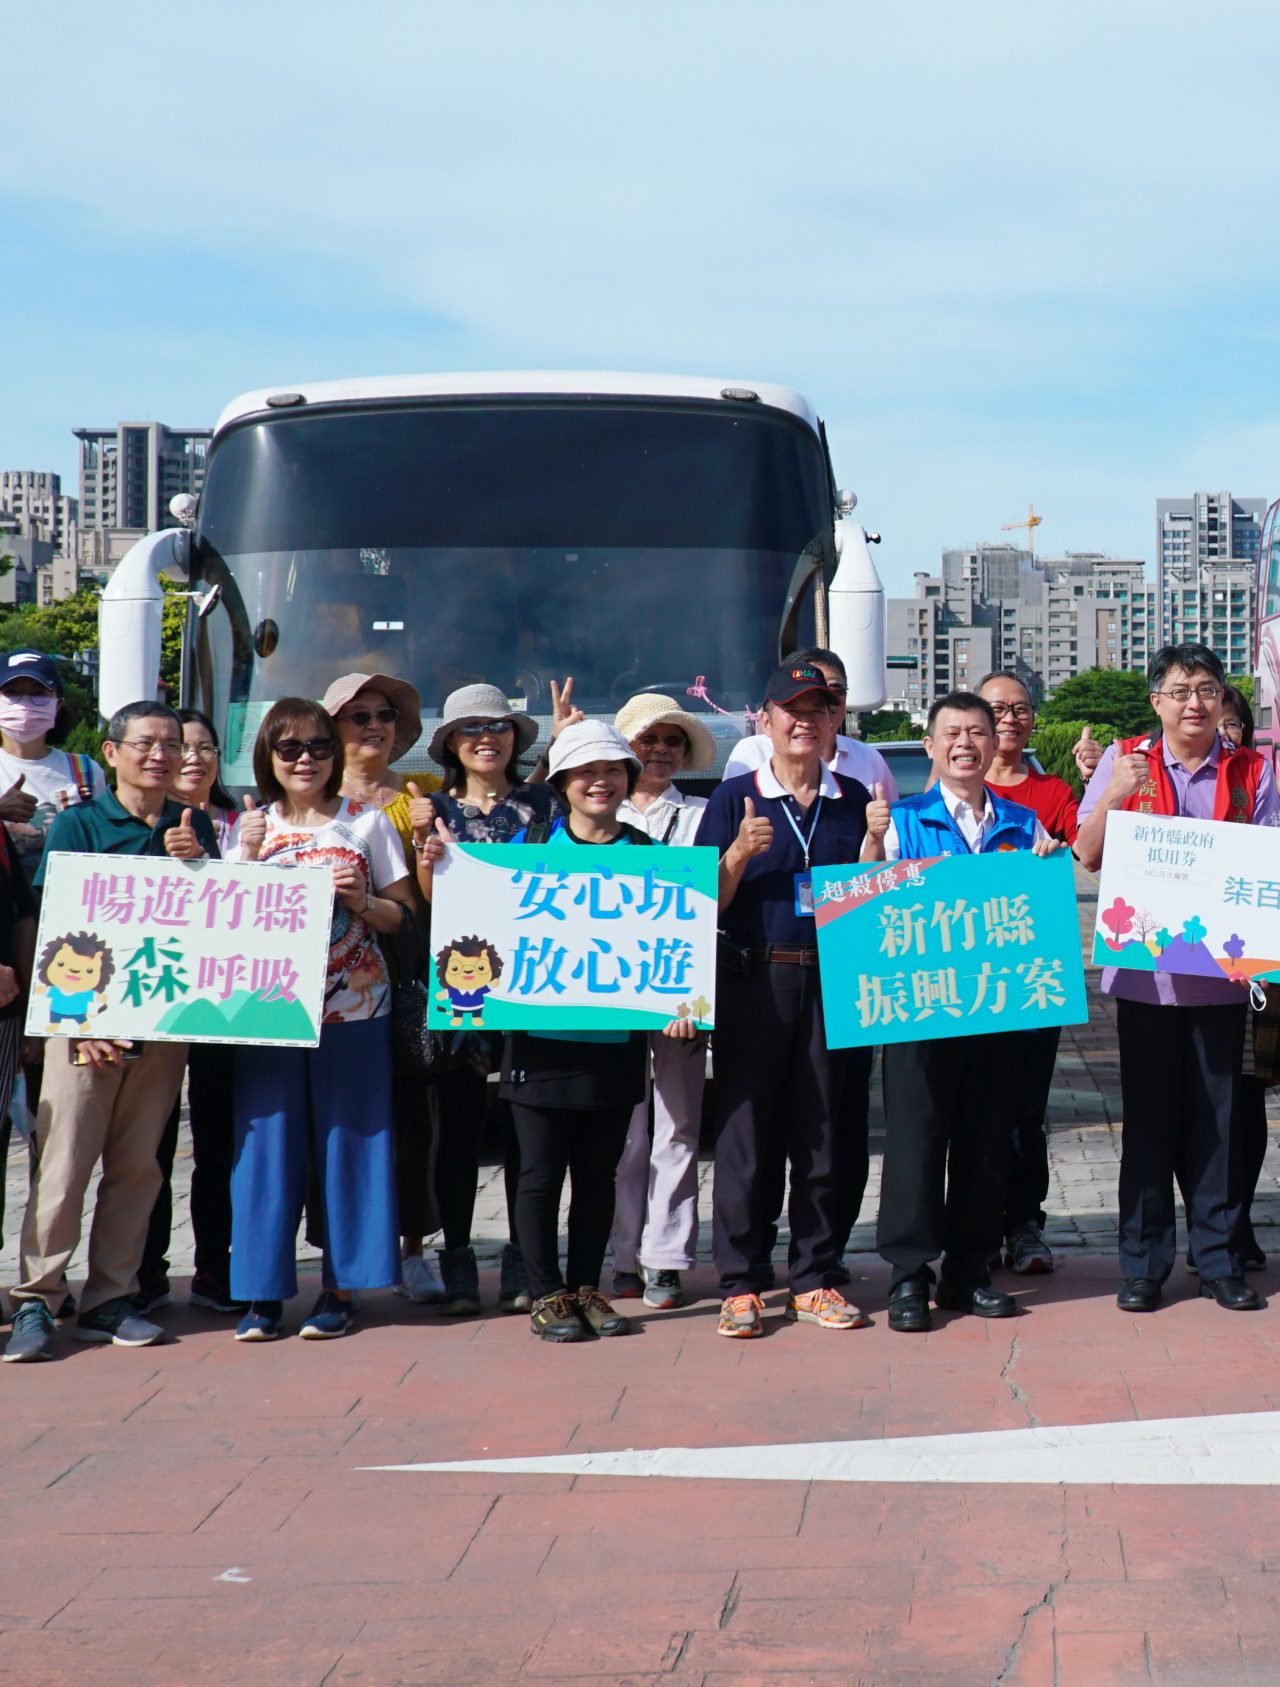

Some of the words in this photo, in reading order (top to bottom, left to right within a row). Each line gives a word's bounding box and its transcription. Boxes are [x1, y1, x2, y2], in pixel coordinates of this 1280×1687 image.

[1134, 825, 1215, 848] 新竹縣政府
[1148, 847, 1196, 866] 抵用券
[81, 872, 309, 933] 暢遊竹縣
[510, 861, 697, 923] 安心玩
[820, 862, 927, 902] 超殺優惠
[877, 893, 1036, 958] 新竹縣
[506, 936, 695, 997] 放心遊
[854, 957, 1067, 1029] 振興方案
